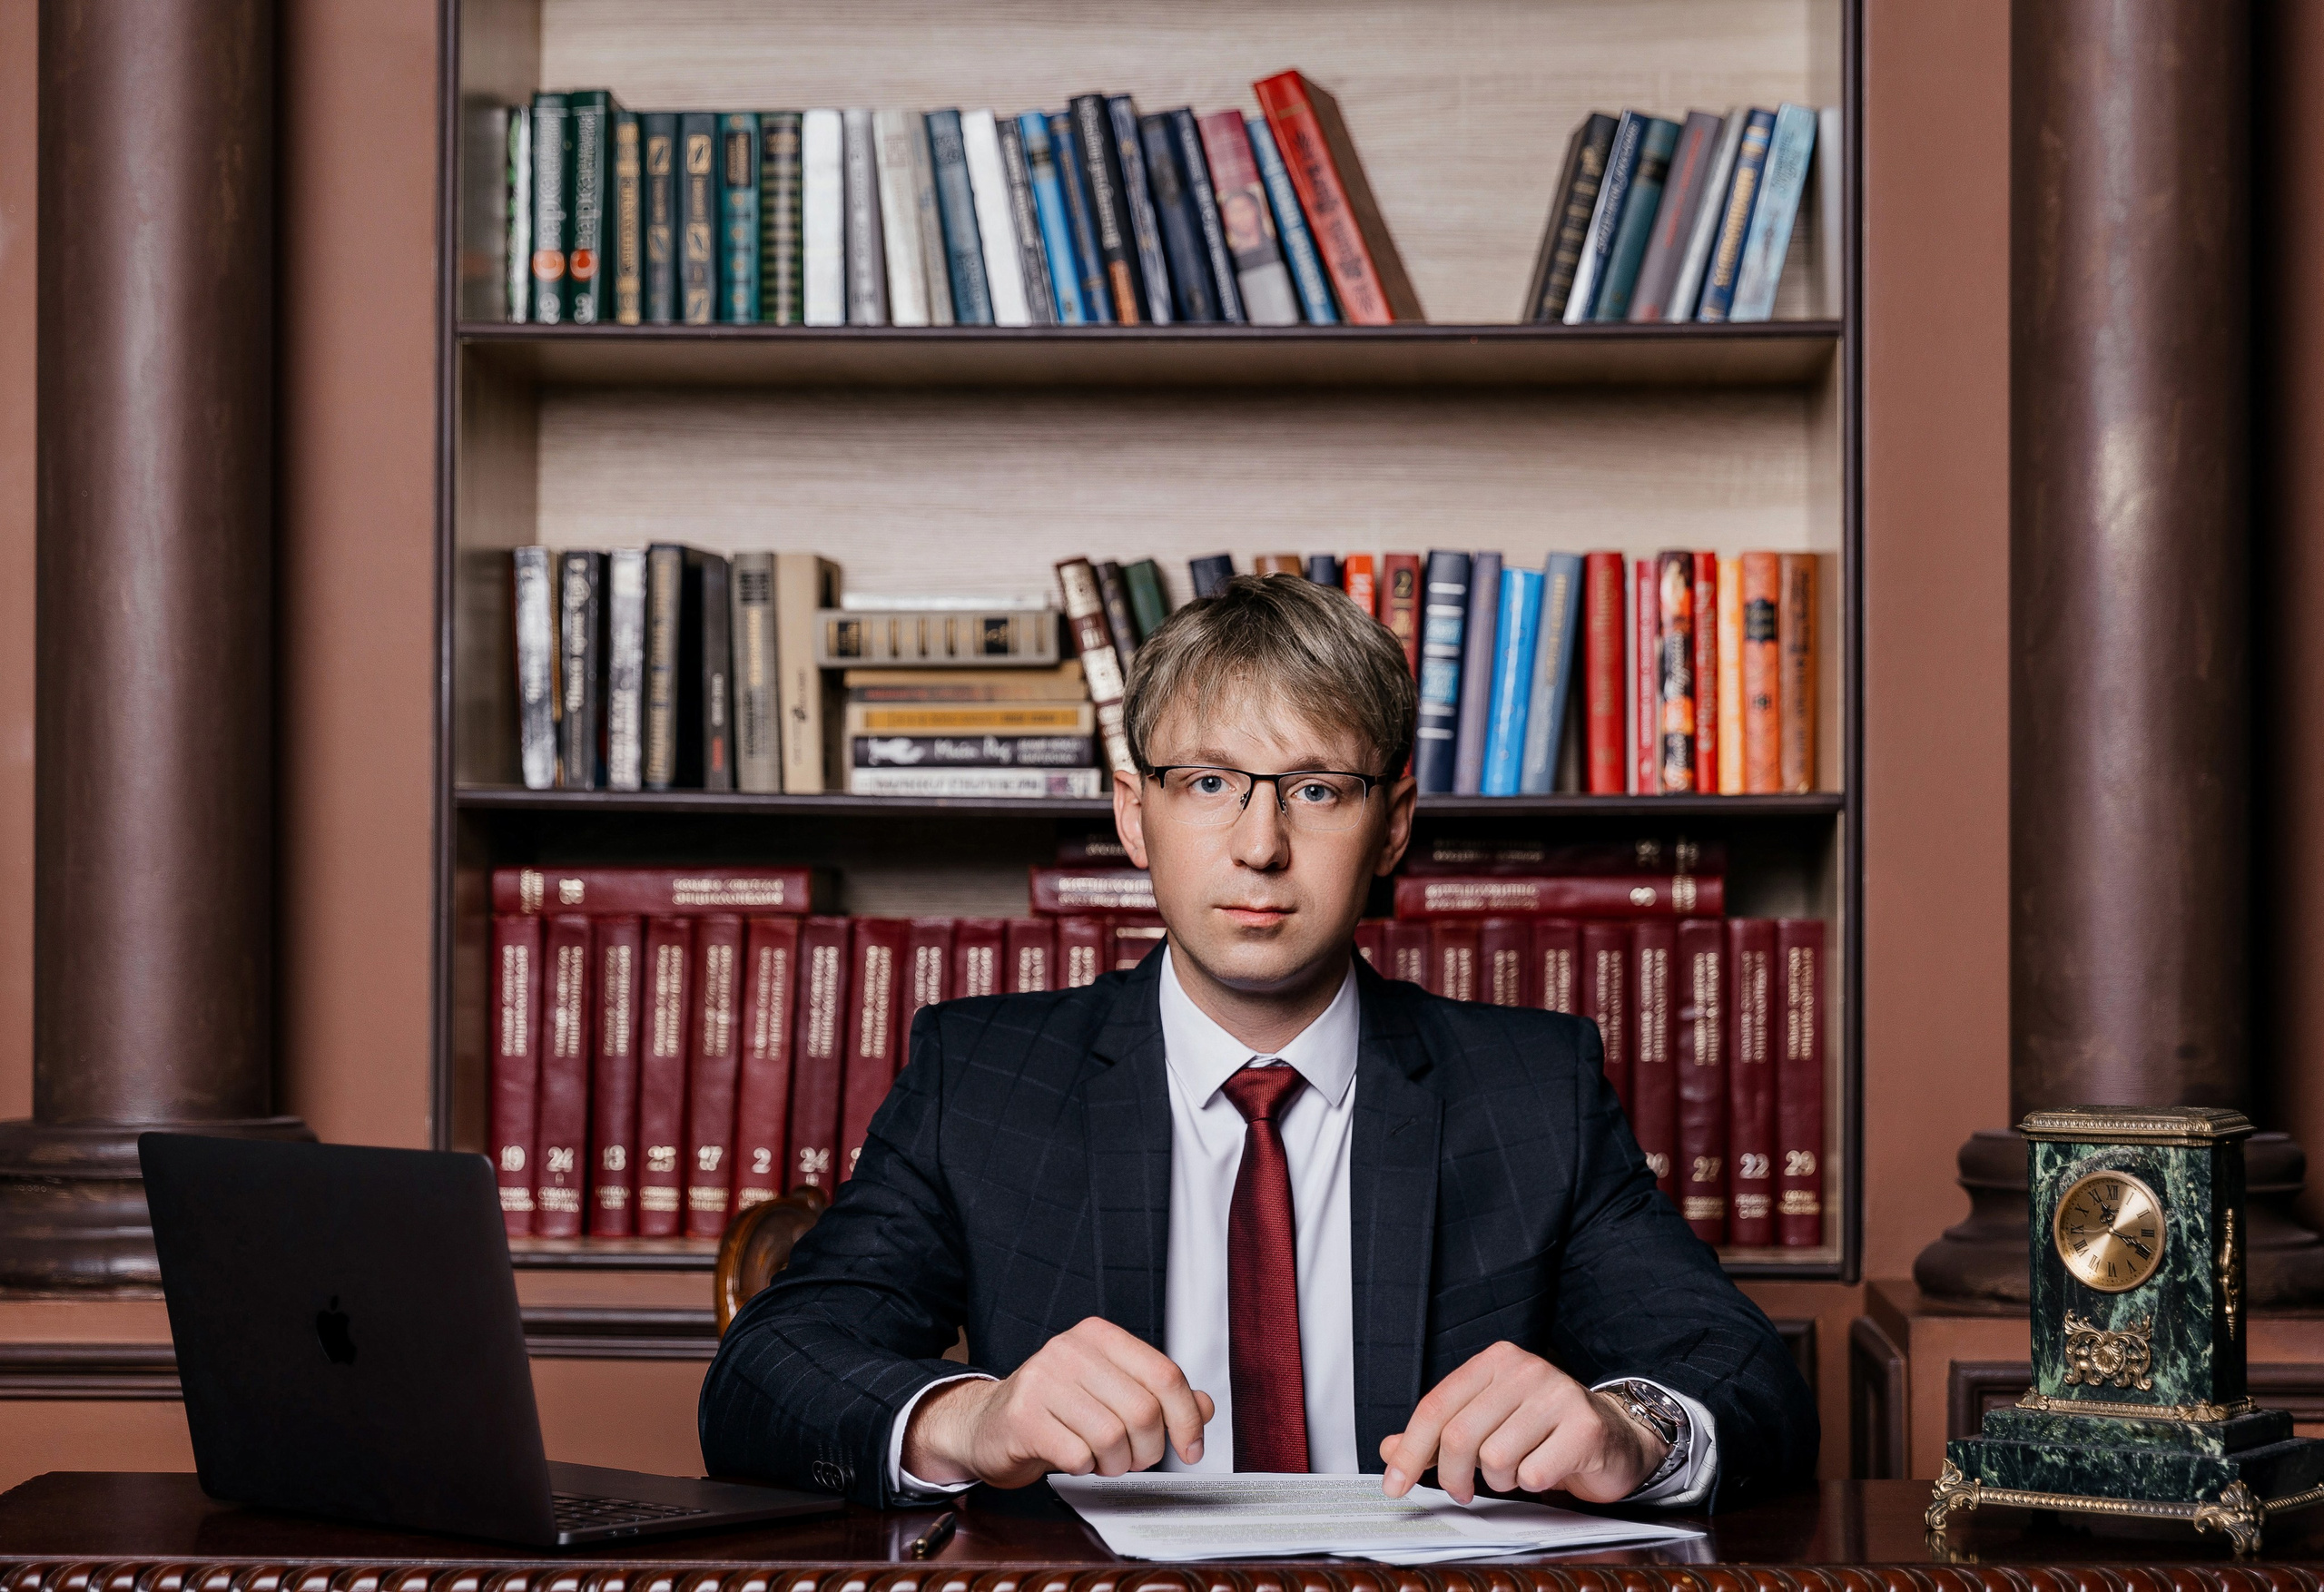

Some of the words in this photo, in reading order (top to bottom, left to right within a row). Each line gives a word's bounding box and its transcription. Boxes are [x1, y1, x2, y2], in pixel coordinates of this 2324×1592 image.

[751, 1146, 772, 1174] 2
[1739, 1152, 1770, 1179] 22
[2089, 1189, 2102, 1205] XI
[2106, 1185, 2118, 1200] XII
[2075, 1205, 2089, 1216] X
[2136, 1209, 2150, 1218] II
[2071, 1224, 2083, 1234] IX
[2141, 1229, 2154, 1238] III
[2108, 1263, 2117, 1277] VI
[2127, 1260, 2136, 1273] V
